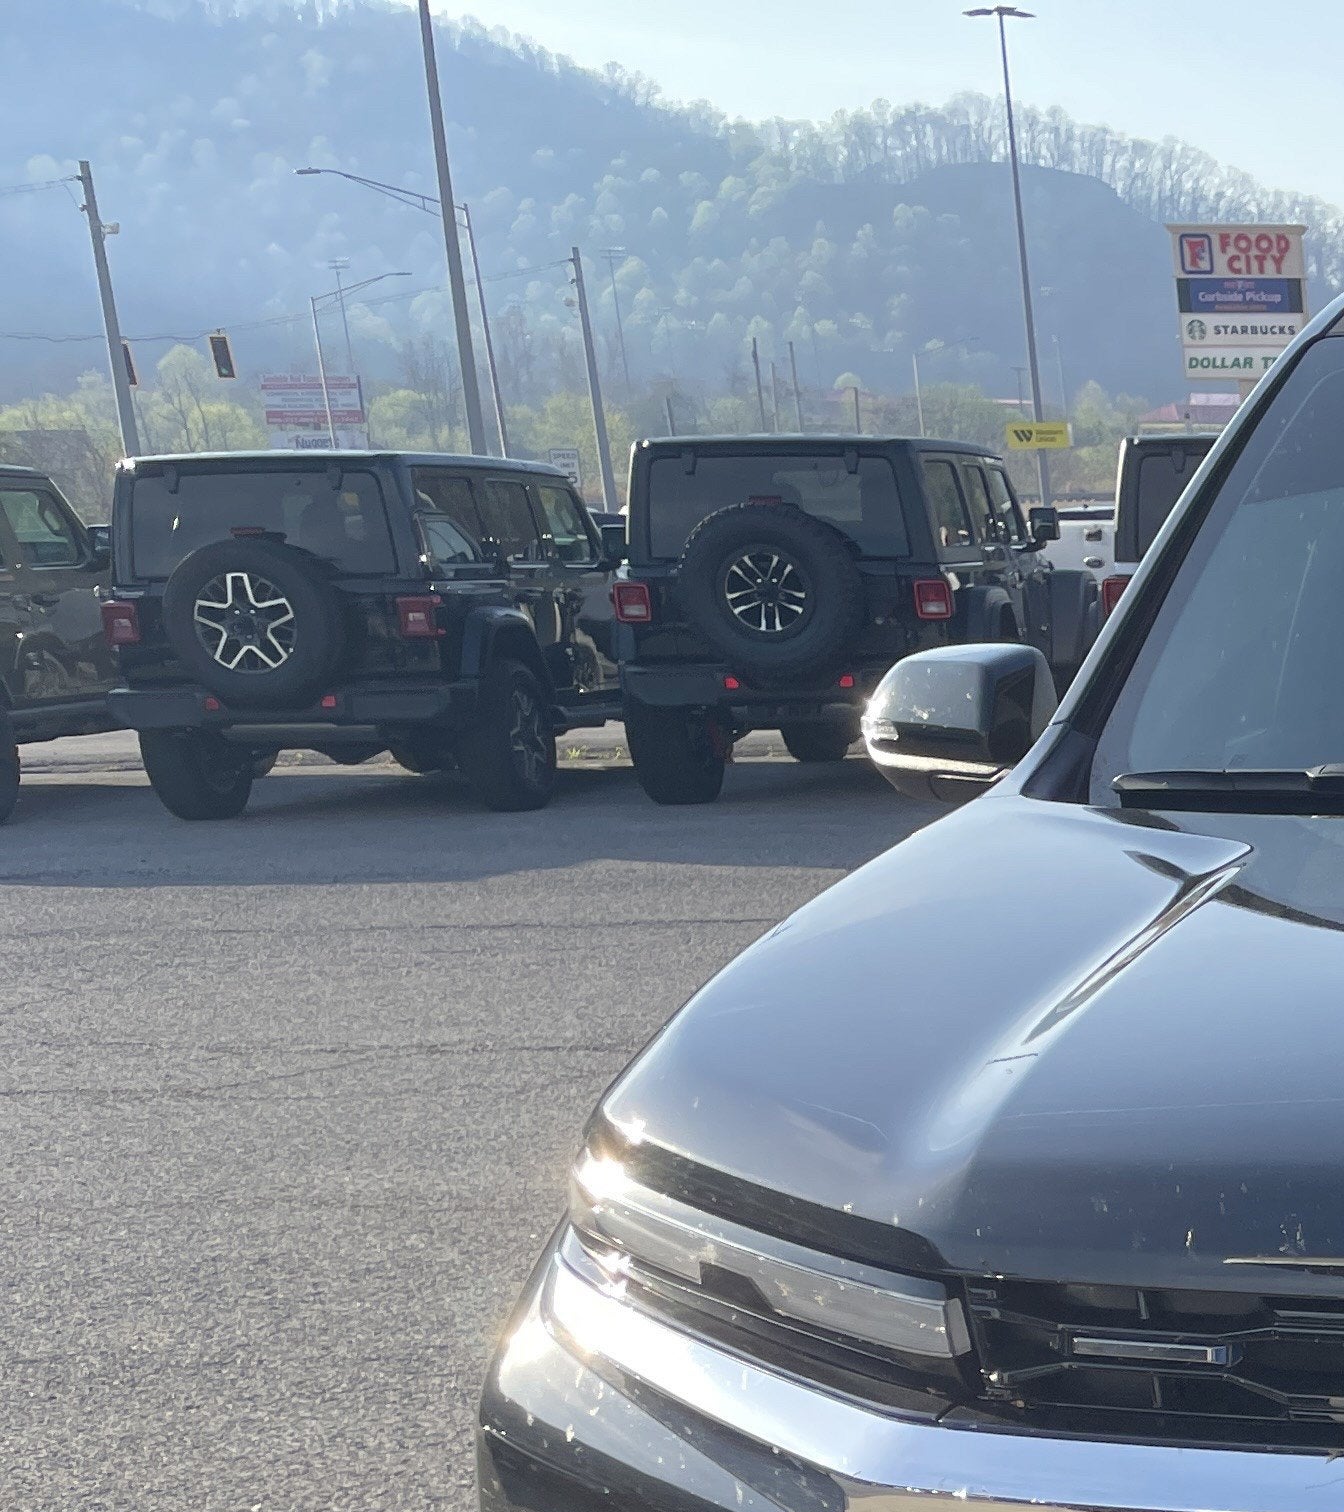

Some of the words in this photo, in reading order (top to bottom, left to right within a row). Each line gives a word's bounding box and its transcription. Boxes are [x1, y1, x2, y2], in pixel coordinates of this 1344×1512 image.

[1219, 233, 1290, 254] FOOD
[1227, 254, 1285, 274] CITY
[1246, 291, 1281, 303] Pickup
[1213, 325, 1296, 335] STARBUCKS
[1188, 357, 1254, 369] DOLLAR
